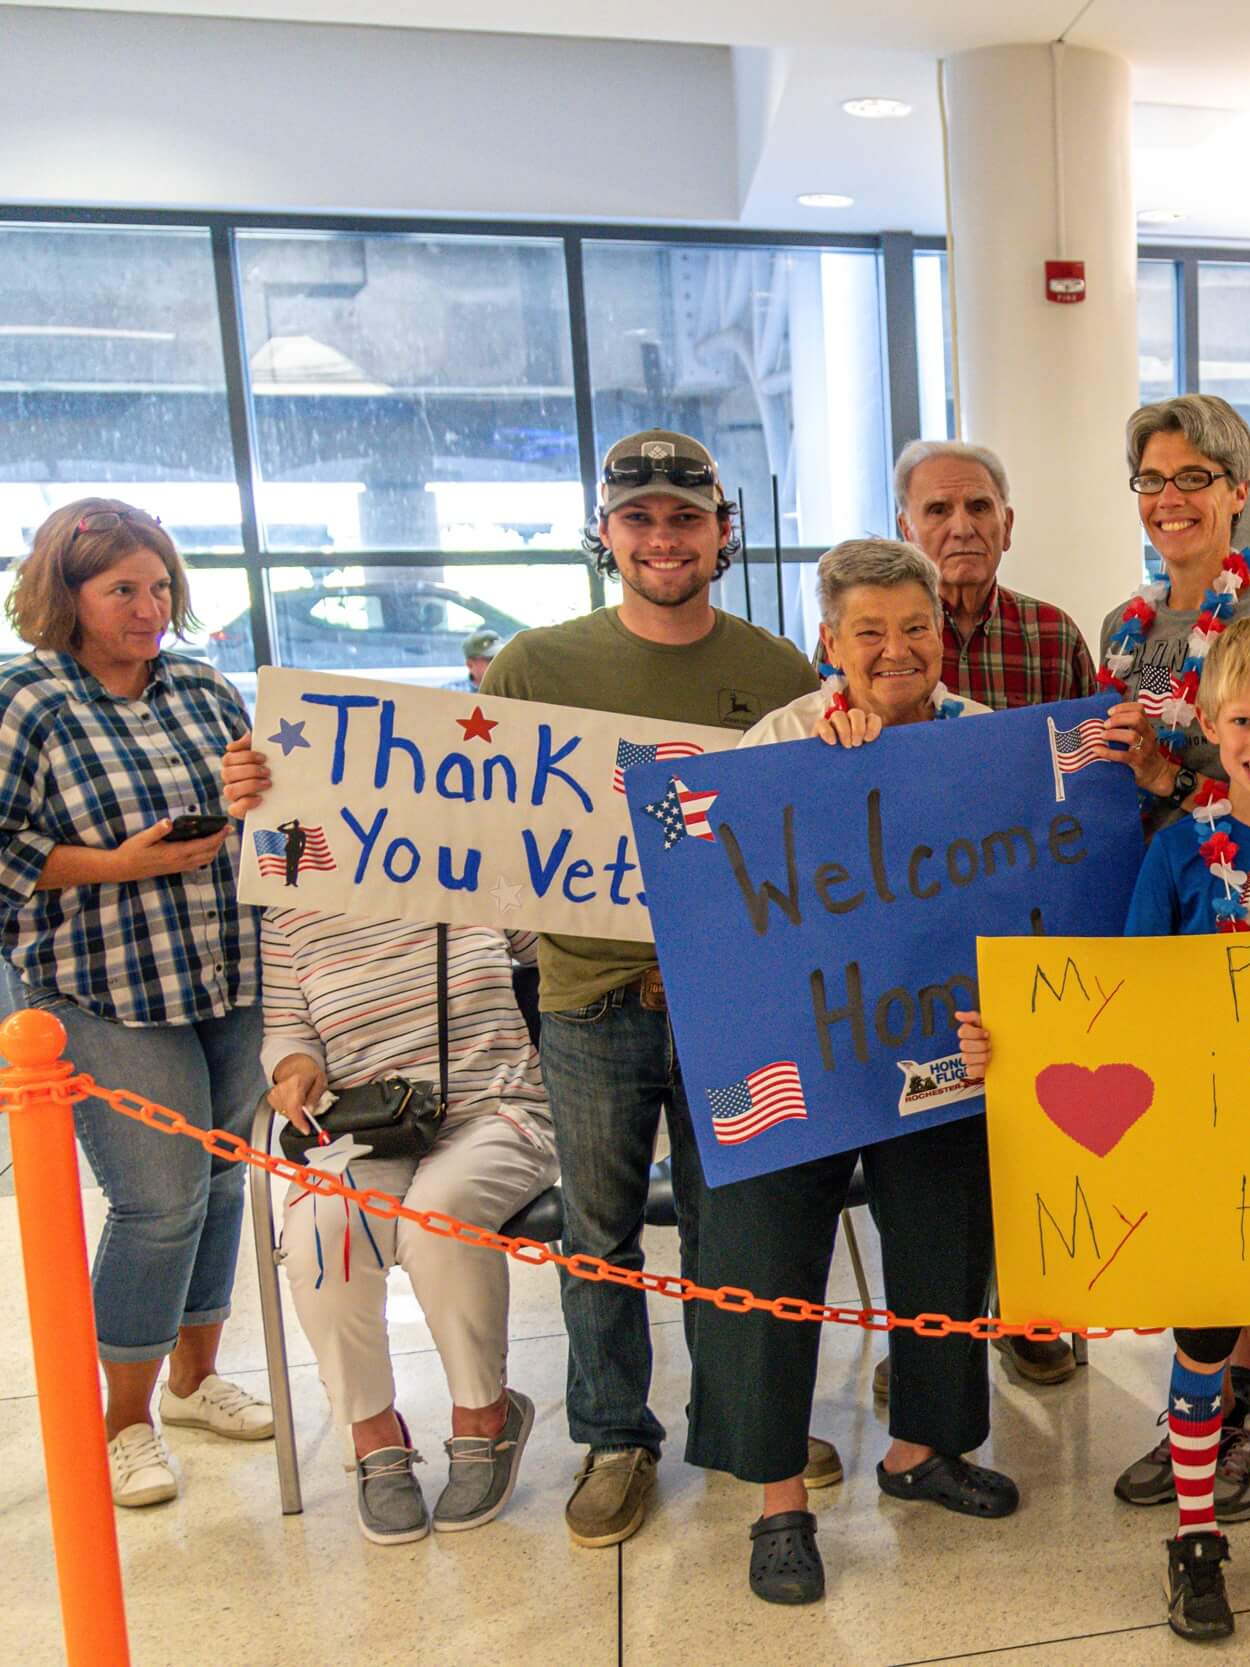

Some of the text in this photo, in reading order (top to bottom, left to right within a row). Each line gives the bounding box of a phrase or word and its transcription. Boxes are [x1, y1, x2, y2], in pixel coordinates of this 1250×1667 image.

[300, 693, 595, 813] Thank
[340, 807, 482, 893] You
[717, 787, 1088, 937] Welcome
[810, 960, 980, 1073] Hom
[1031, 957, 1125, 1034] My
[1036, 1174, 1148, 1292] My
